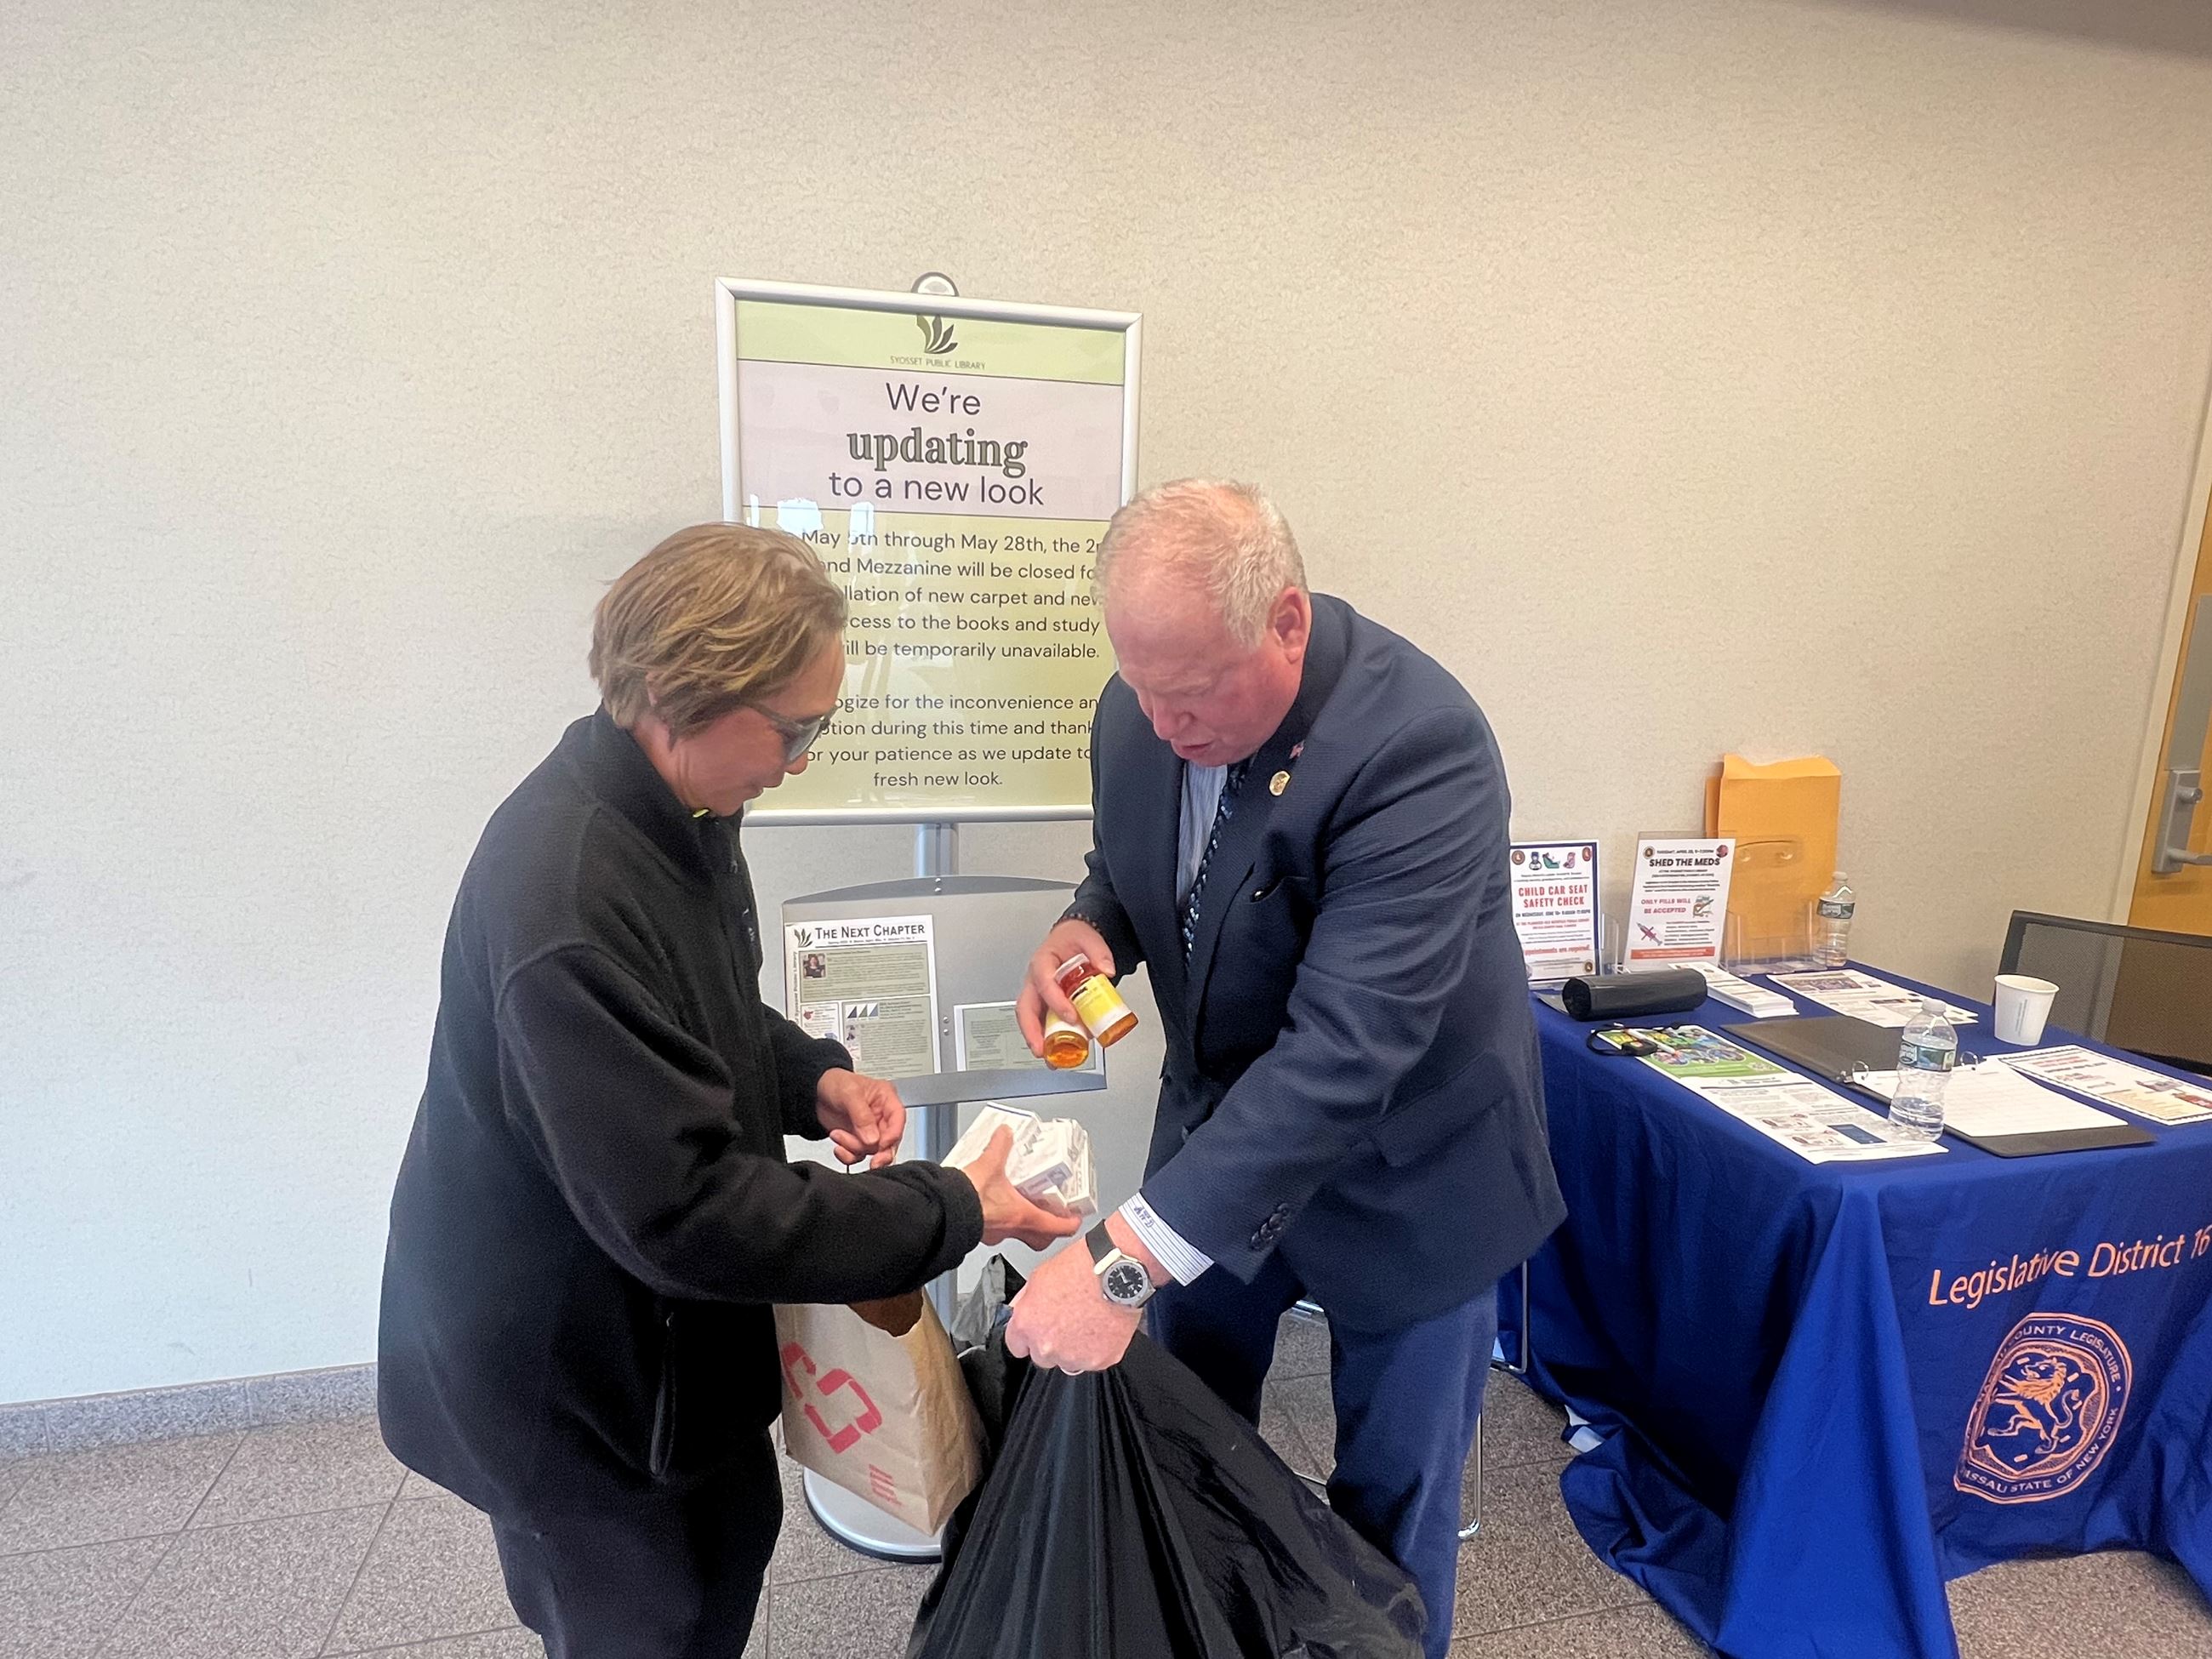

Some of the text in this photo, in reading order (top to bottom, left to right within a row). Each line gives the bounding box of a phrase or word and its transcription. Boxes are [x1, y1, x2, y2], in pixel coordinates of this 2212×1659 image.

[890, 355, 986, 370] SYOSSET PUBLIC LIBRARY
[886, 382, 981, 416] We're
[847, 426, 1028, 478] updating
[829, 470, 1044, 506] to a new look
[802, 529, 841, 549] May
[884, 531, 955, 552] through
[961, 533, 998, 554] May
[1003, 535, 1047, 554] 28th,
[1052, 538, 1080, 553] the
[858, 558, 952, 576] Mezzanine
[957, 562, 984, 577] will
[990, 562, 1013, 578] be
[1018, 563, 1075, 579] closed
[905, 587, 922, 603] of
[928, 590, 964, 604] new
[970, 591, 1029, 607] carpet
[1034, 590, 1065, 606] and
[898, 615, 915, 630] to
[922, 614, 951, 630] the
[956, 614, 1010, 631] books
[1015, 617, 1047, 632] and
[1052, 617, 1100, 636] study
[865, 640, 887, 656] be
[894, 641, 996, 660] temporarily
[1001, 642, 1099, 658] unavailable.
[885, 693, 910, 710] for
[915, 694, 944, 710] the
[949, 694, 1074, 710] inconvenience
[871, 720, 927, 738] during
[932, 720, 965, 735] this
[970, 720, 1008, 735] time
[1013, 720, 1045, 735] and
[830, 750, 869, 766] your
[875, 746, 953, 765] patience
[958, 750, 978, 761] as
[983, 750, 1006, 761] we
[1012, 746, 1072, 764] update
[874, 771, 1003, 787] fresh new look.
[1649, 858, 1720, 867] SHED THE MEDS
[1518, 884, 1588, 897] CHILD CAR SEAT
[1523, 896, 1584, 909] SAFETY CHECK
[814, 924, 926, 939] THE NEXT CHAPTER
[1929, 1223, 2212, 1308] Legislative District 16
[2010, 1325, 2122, 1383] OUNTY LEGISLATURE
[2010, 1479, 2052, 1493] STATE
[2056, 1469, 2072, 1484] OF
[2076, 1443, 2100, 1470] NEW
[2098, 1406, 2118, 1440] YORK
